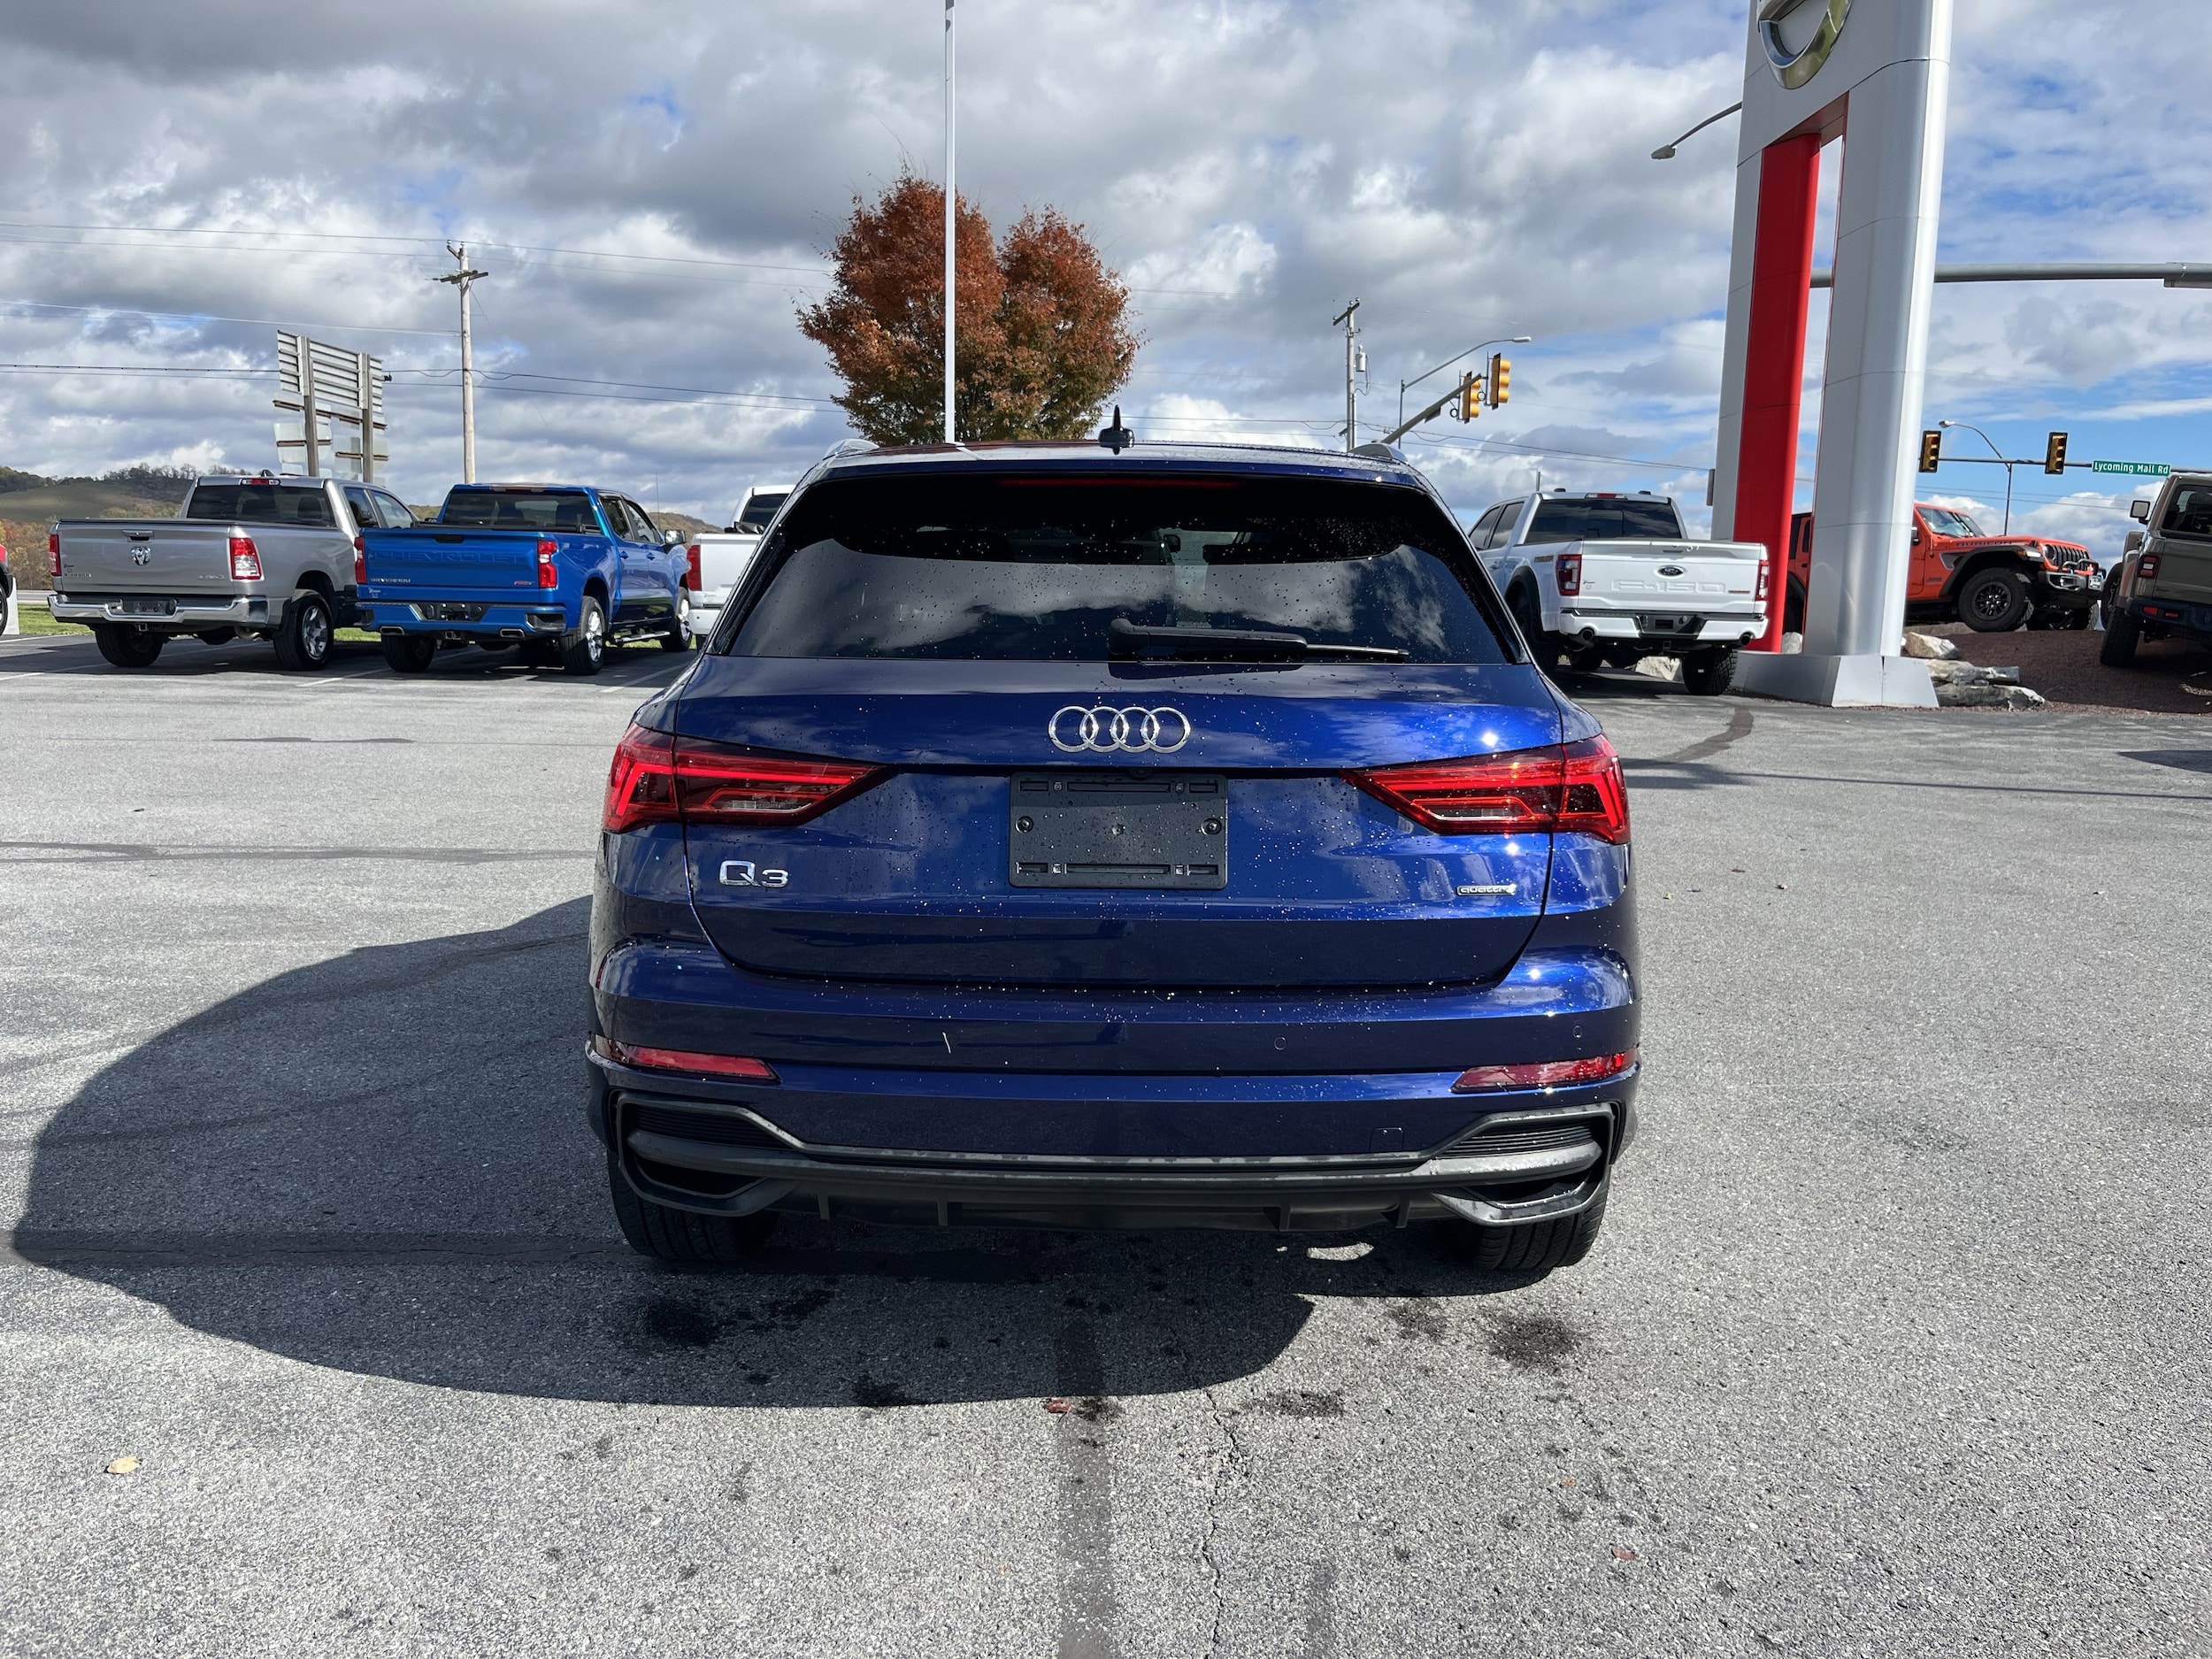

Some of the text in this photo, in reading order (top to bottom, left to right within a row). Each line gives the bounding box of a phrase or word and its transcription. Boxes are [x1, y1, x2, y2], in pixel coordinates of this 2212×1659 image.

[2094, 462, 2169, 474] Lycoming Mall Rd
[374, 550, 524, 564] CHEVROLET
[1610, 580, 1725, 595] F-150
[719, 860, 788, 887] Q3
